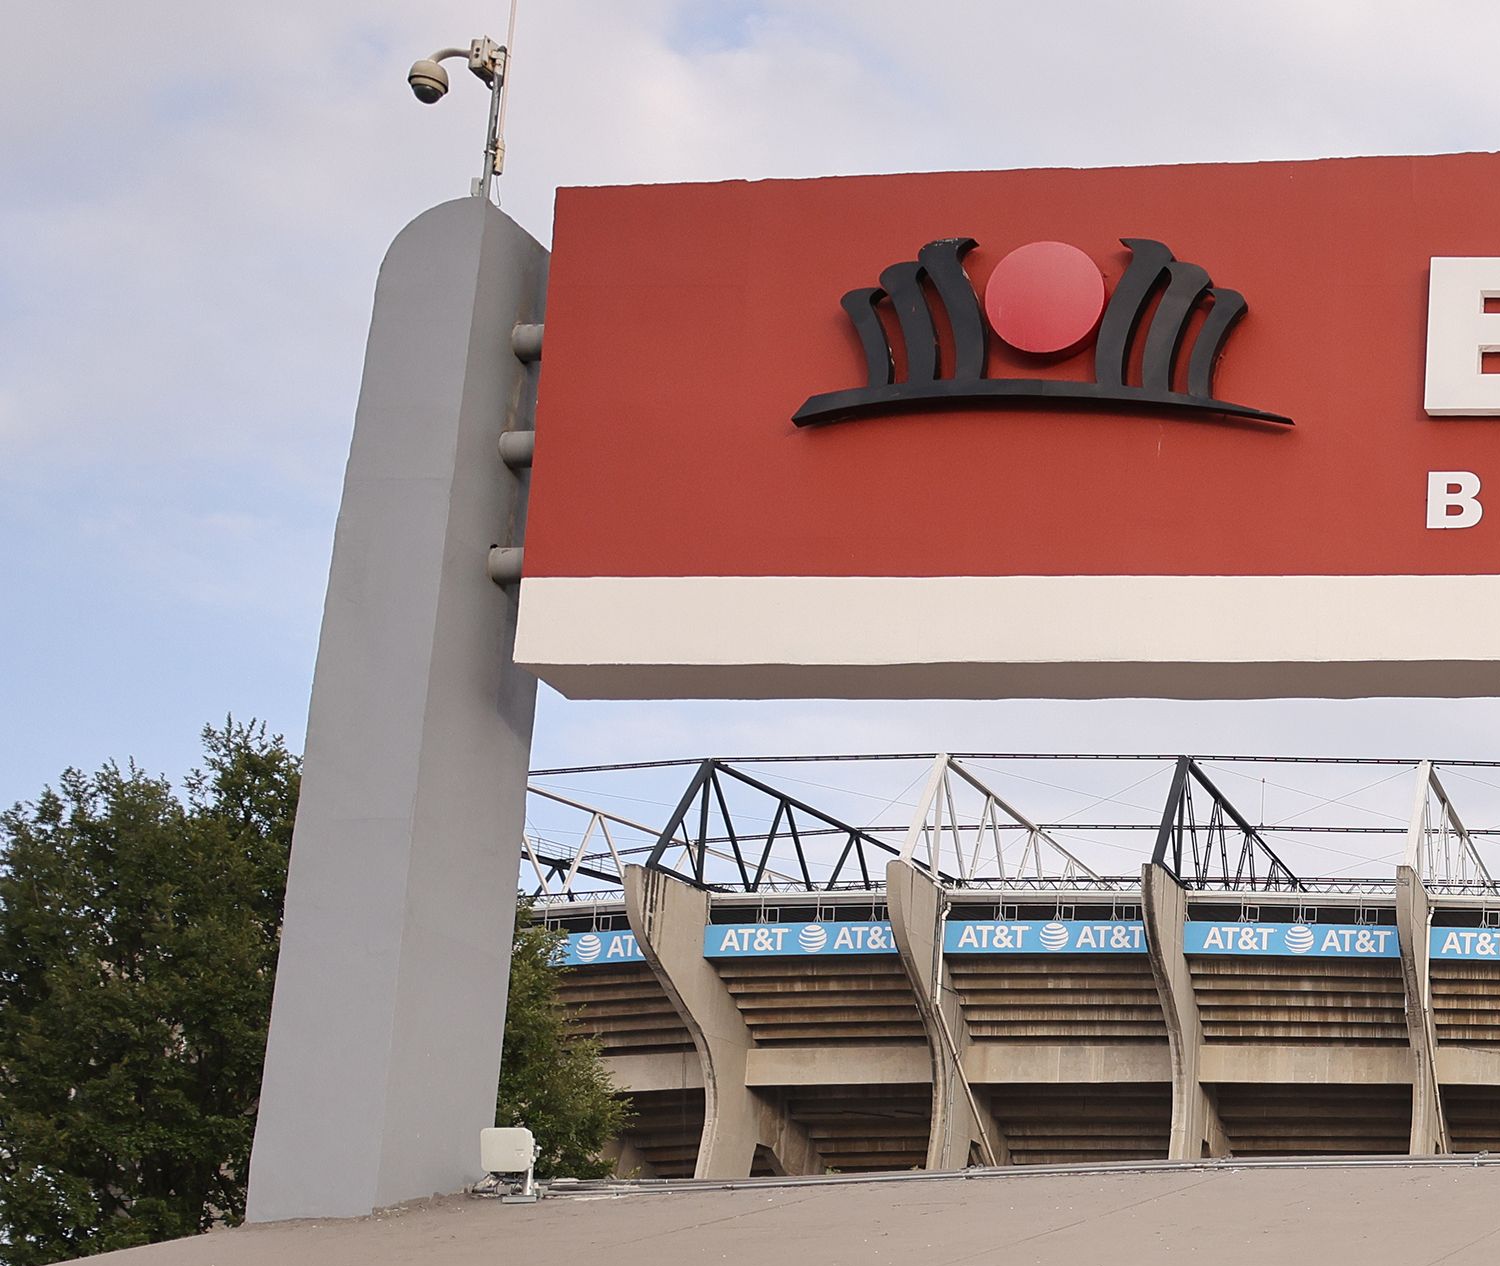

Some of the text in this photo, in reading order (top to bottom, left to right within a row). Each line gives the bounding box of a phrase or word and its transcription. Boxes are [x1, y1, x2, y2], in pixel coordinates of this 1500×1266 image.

[607, 935, 645, 958] AT
[720, 928, 789, 951] AT&T
[957, 925, 1143, 949] AT&T AT&T
[1203, 927, 1393, 953] AT&T AT&T
